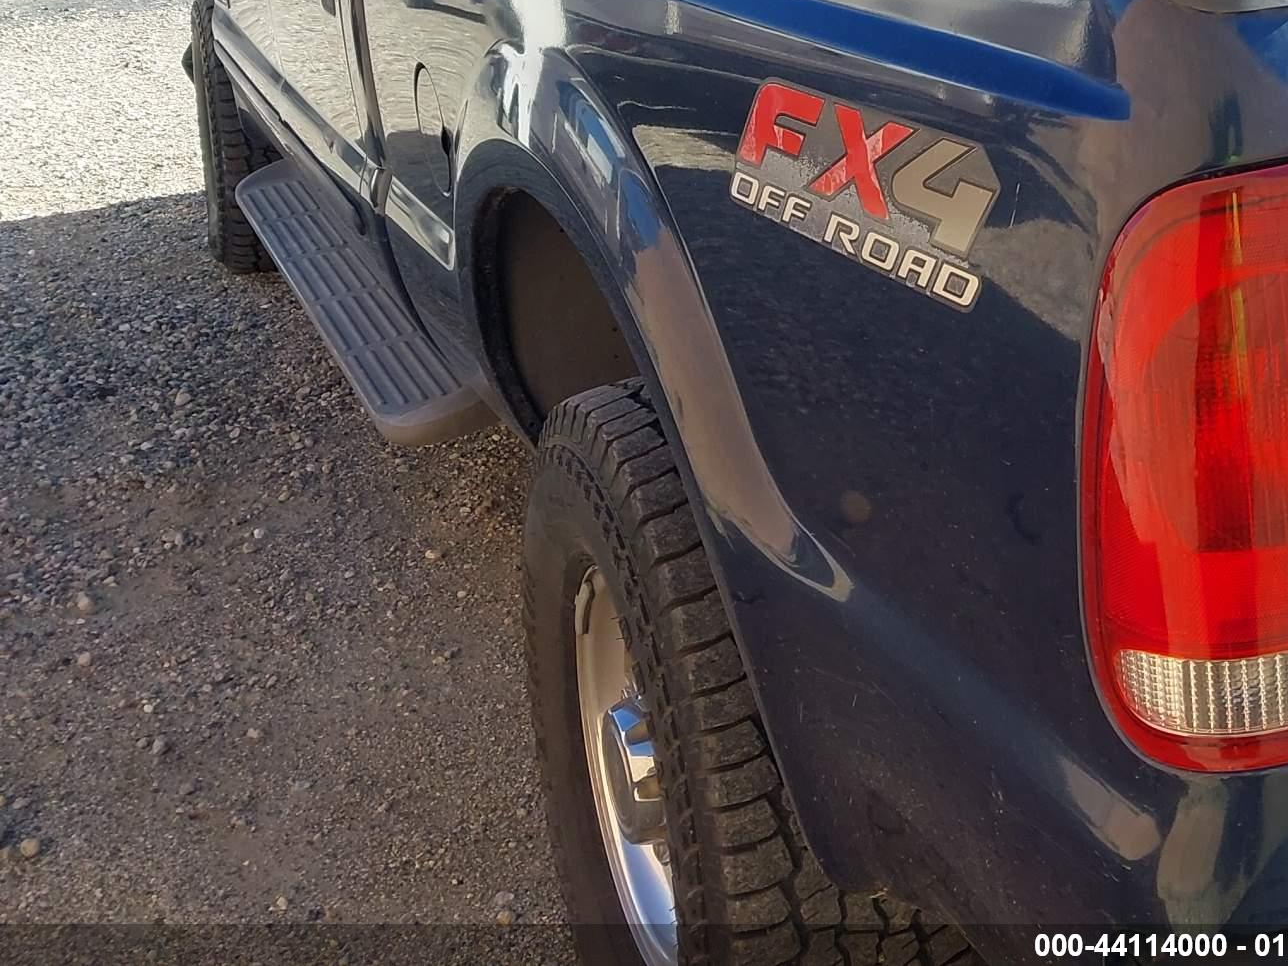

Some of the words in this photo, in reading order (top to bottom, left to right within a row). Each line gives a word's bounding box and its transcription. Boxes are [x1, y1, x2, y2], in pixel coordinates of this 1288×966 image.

[730, 171, 811, 223] OFF
[823, 213, 980, 307] ROAD
[739, 82, 995, 253] FX4
